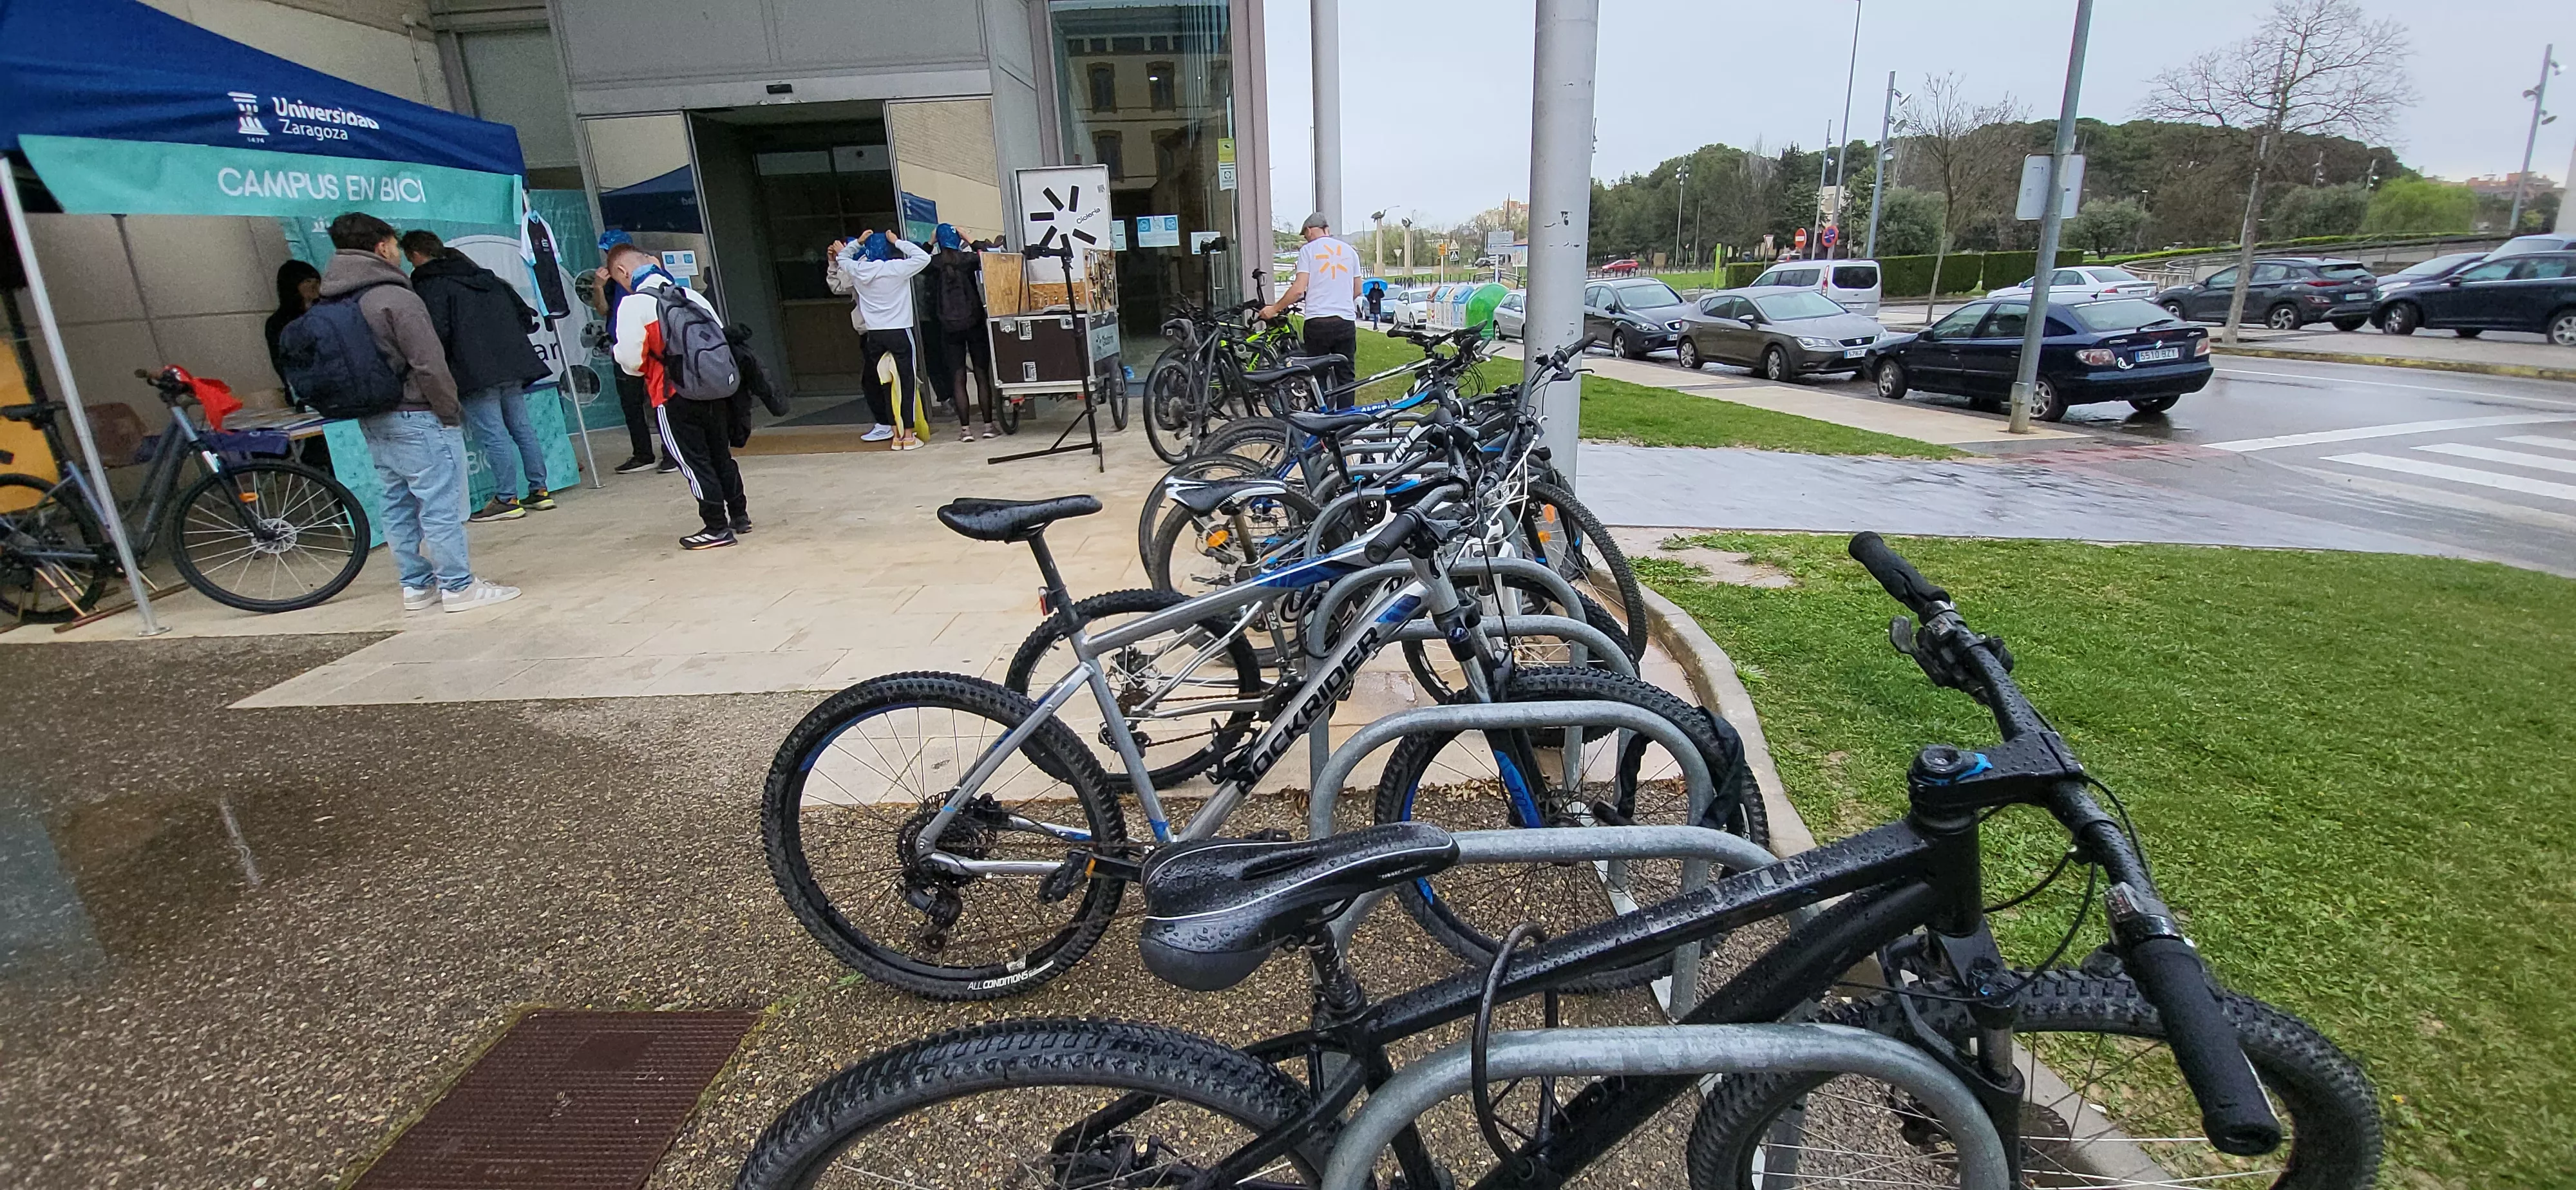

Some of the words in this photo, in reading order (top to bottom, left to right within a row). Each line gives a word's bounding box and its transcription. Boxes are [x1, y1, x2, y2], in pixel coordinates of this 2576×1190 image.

[278, 118, 348, 141] Zaragoza
[218, 167, 340, 200] CAMPUS
[346, 175, 375, 201] EN
[380, 177, 427, 203] BICI
[967, 981, 983, 991] ALL
[983, 970, 1028, 989] CONDITIONS
